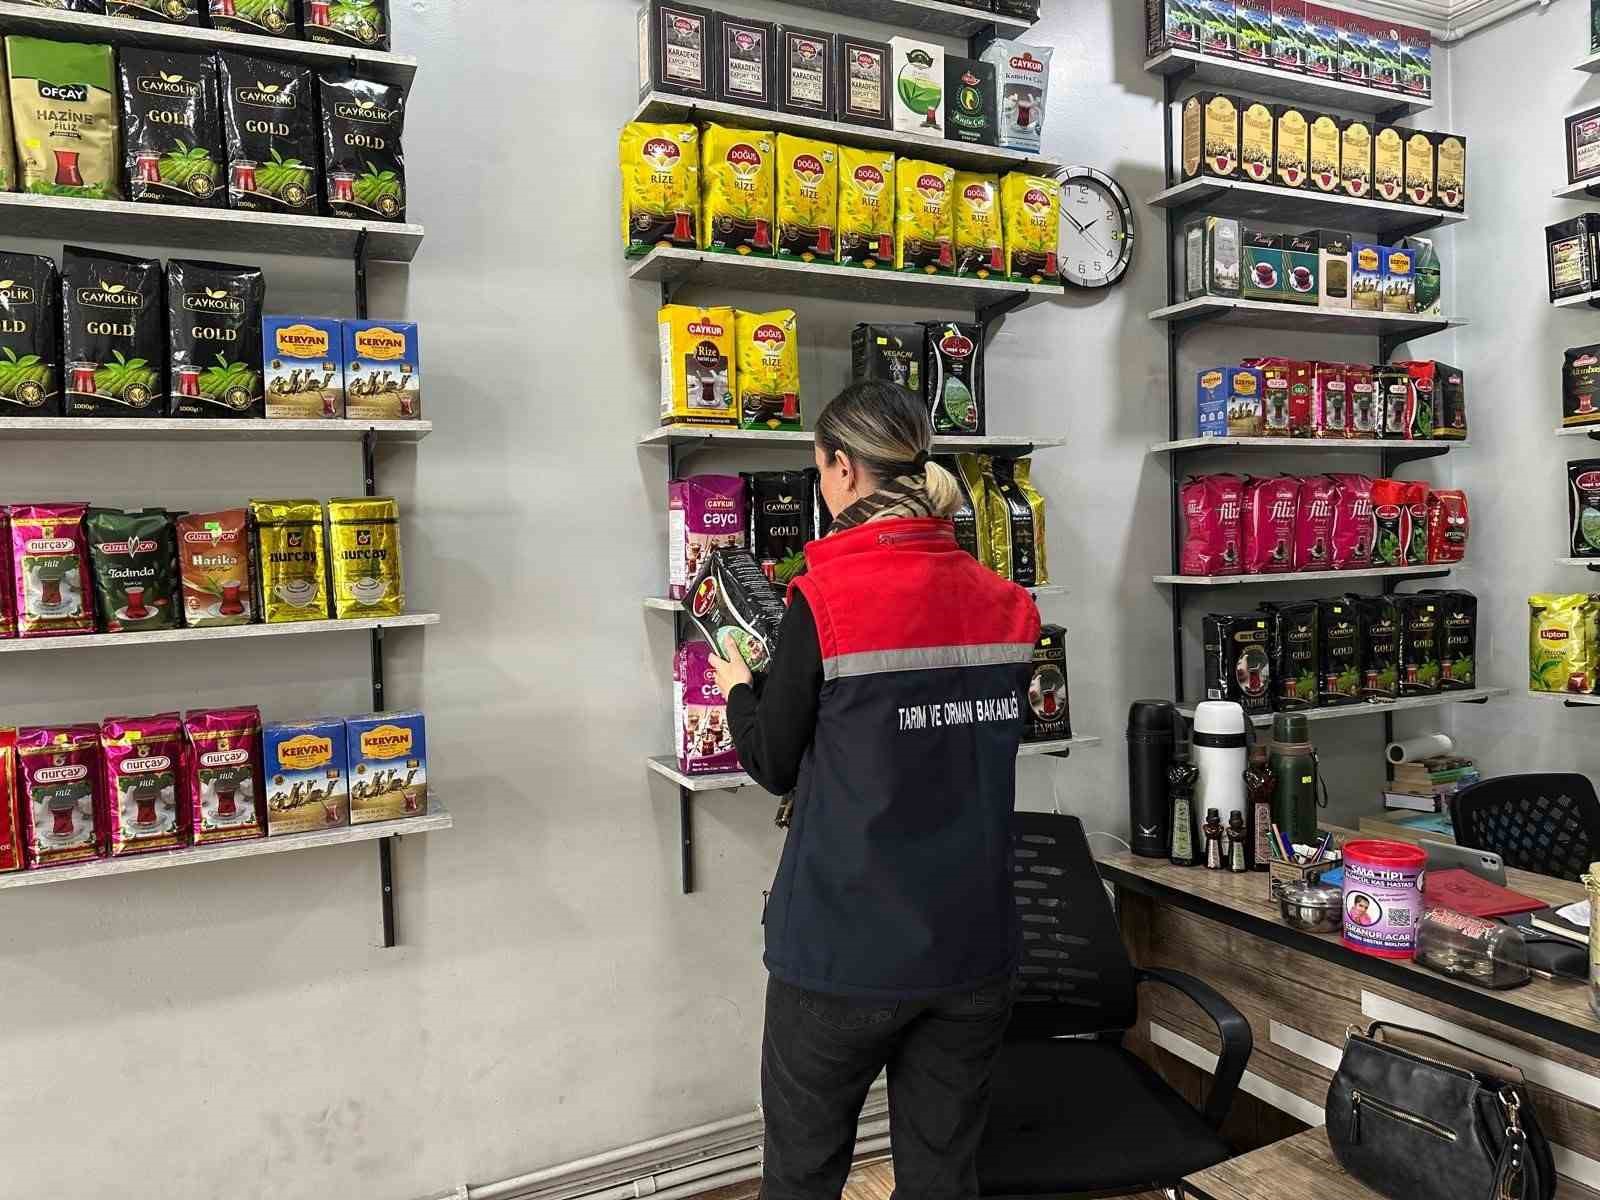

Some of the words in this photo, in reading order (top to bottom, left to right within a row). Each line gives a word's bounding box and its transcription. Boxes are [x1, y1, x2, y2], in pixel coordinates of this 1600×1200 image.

[41, 87, 84, 101] OFÇAY
[142, 81, 199, 97] ÇAYKOLİK
[37, 109, 95, 125] HAZİNE
[338, 106, 388, 121] ÇAYKOLİK
[245, 120, 290, 136] GOLD
[344, 133, 385, 150] GOLD
[648, 143, 676, 155] DOĞUŞ
[731, 149, 757, 162] DOĞUŞ
[797, 159, 820, 171] DOĞUŞ
[651, 172, 673, 184] RİZE
[734, 179, 756, 192] RİZE
[1063, 187, 1072, 197] 11
[1079, 184, 1089, 195] 12
[1105, 211, 1114, 221] 2
[1111, 230, 1118, 240] 3
[1106, 248, 1113, 258] 4
[1062, 256, 1069, 265] 7
[1094, 261, 1102, 272] 5
[1078, 264, 1086, 274] 6
[82, 291, 138, 305] ÇAYKOLİK
[187, 295, 240, 312] ÇAYKOLİK
[87, 321, 135, 337] GOLD
[191, 326, 237, 341] GOLD
[757, 329, 782, 340] DOĞUŞ
[280, 334, 326, 347] KERVAN
[358, 336, 402, 348] KERVAN
[761, 357, 782, 368] RİZE
[1268, 500, 1296, 522] filiz
[703, 513, 738, 528] çaycı
[187, 532, 212, 542] GÜZEL
[769, 526, 799, 537] GOLD
[31, 540, 68, 551] nurçay
[192, 555, 238, 566] Harika
[108, 566, 155, 579] Tadında
[1542, 630, 1567, 639] Lipton
[898, 704, 927, 730] TARIM
[928, 704, 942, 727] VE
[944, 700, 974, 726] ORMAN
[364, 734, 409, 747] KERVAN
[280, 744, 329, 757] KERVAN
[126, 758, 164, 771] nurçay
[206, 752, 242, 765] nurçay
[41, 767, 82, 780] nurçay
[1351, 864, 1375, 877] SMA
[1371, 879, 1386, 887] KAS
[1386, 933, 1410, 941] ACAR
